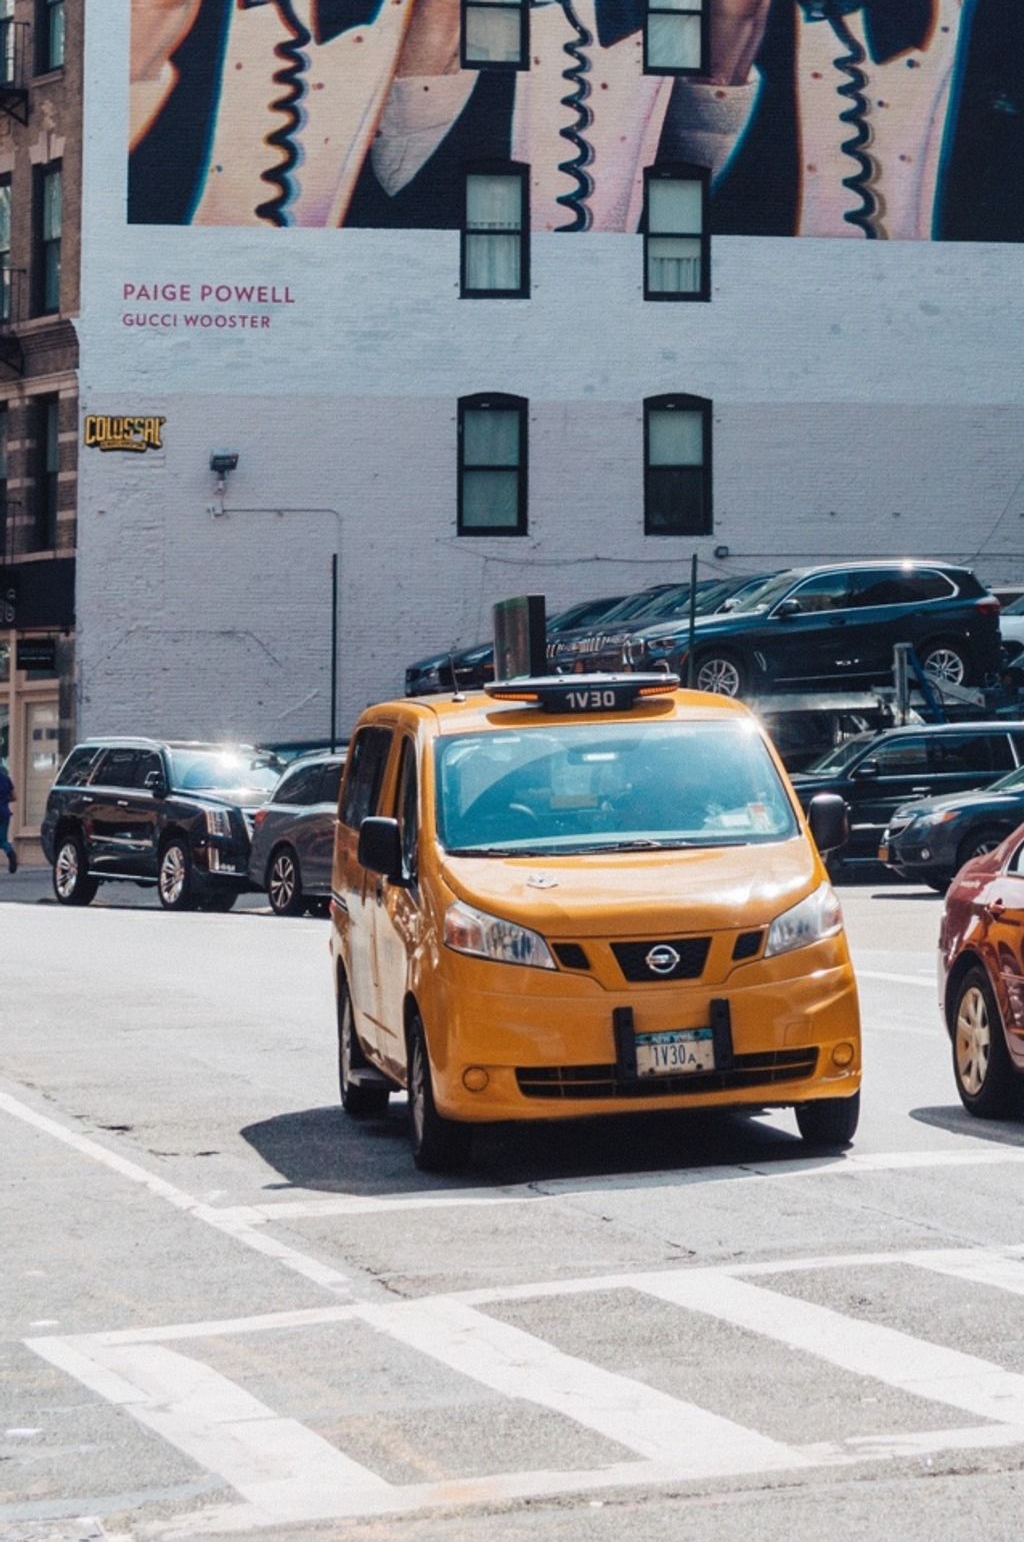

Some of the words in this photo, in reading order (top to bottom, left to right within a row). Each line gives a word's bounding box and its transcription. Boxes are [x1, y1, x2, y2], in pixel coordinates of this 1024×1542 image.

[123, 283, 192, 302] PAIGE
[200, 284, 296, 304] POWELL
[122, 313, 177, 328] GUCCI
[184, 314, 271, 329] WOOSTER
[85, 415, 163, 446] COLOSSAL
[565, 690, 616, 708] 1V30
